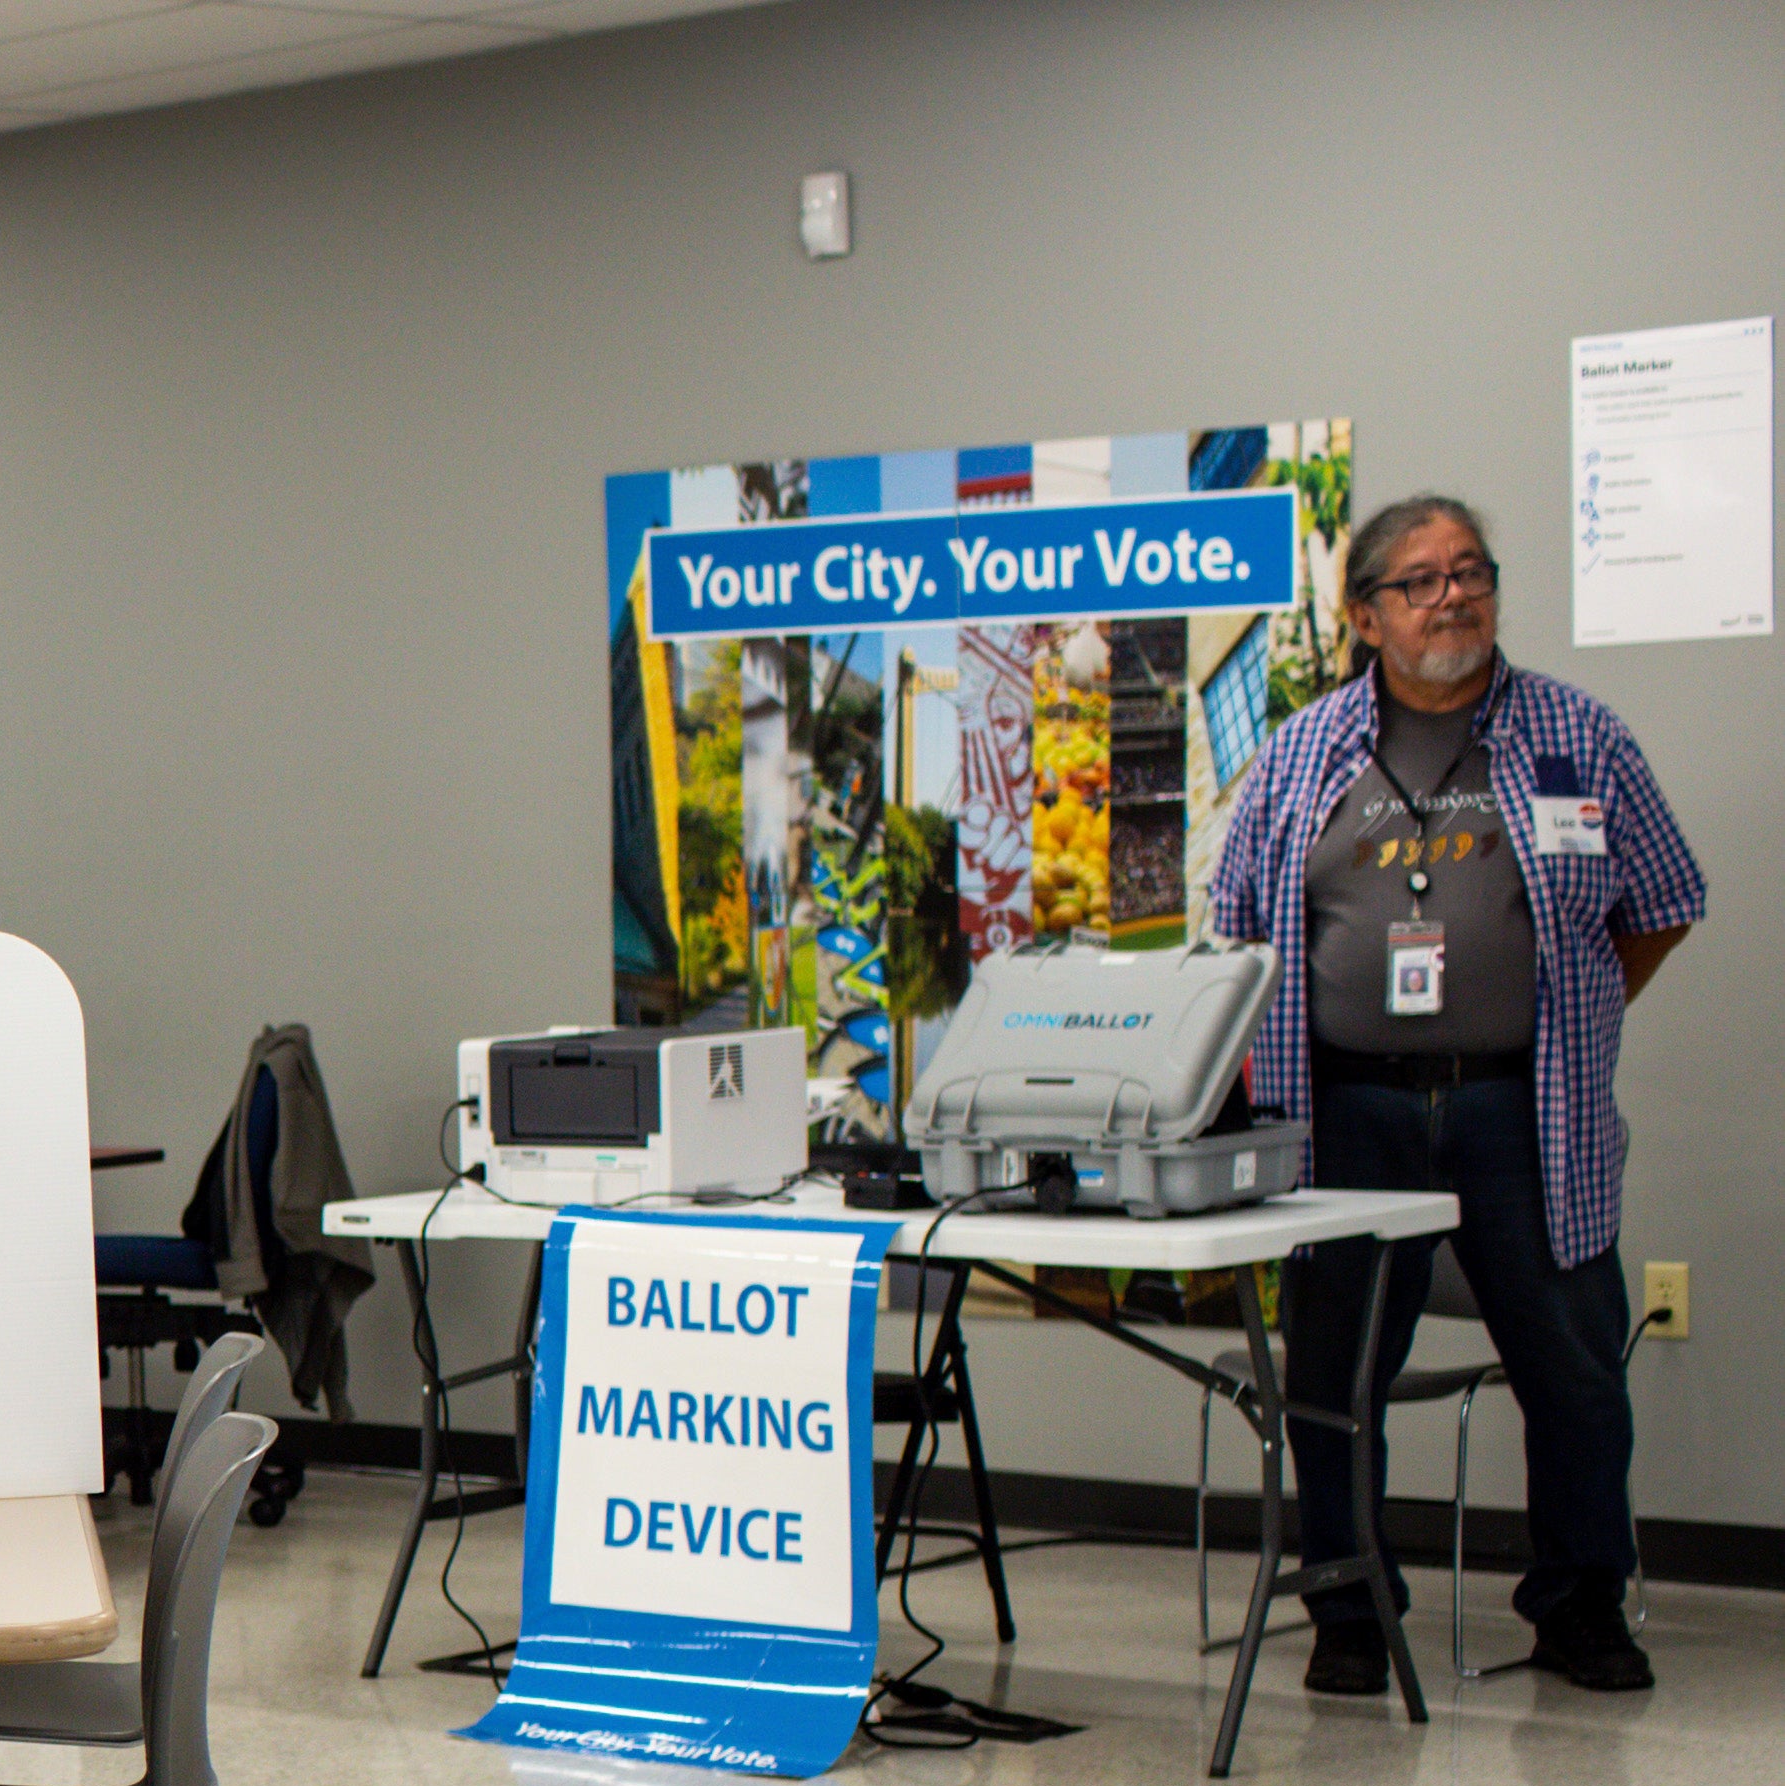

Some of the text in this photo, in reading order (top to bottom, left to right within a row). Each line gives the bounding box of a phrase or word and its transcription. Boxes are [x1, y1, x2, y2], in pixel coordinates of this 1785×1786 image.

[678, 528, 1251, 614] Your City. Your Vote.
[1003, 1011, 1154, 1030] OMNIBALLOT
[607, 1276, 809, 1338] BALLOT
[577, 1384, 834, 1454] MARKING
[603, 1496, 803, 1564] DEVICE
[515, 1721, 579, 1742] Your
[708, 1743, 779, 1770] Vote.
